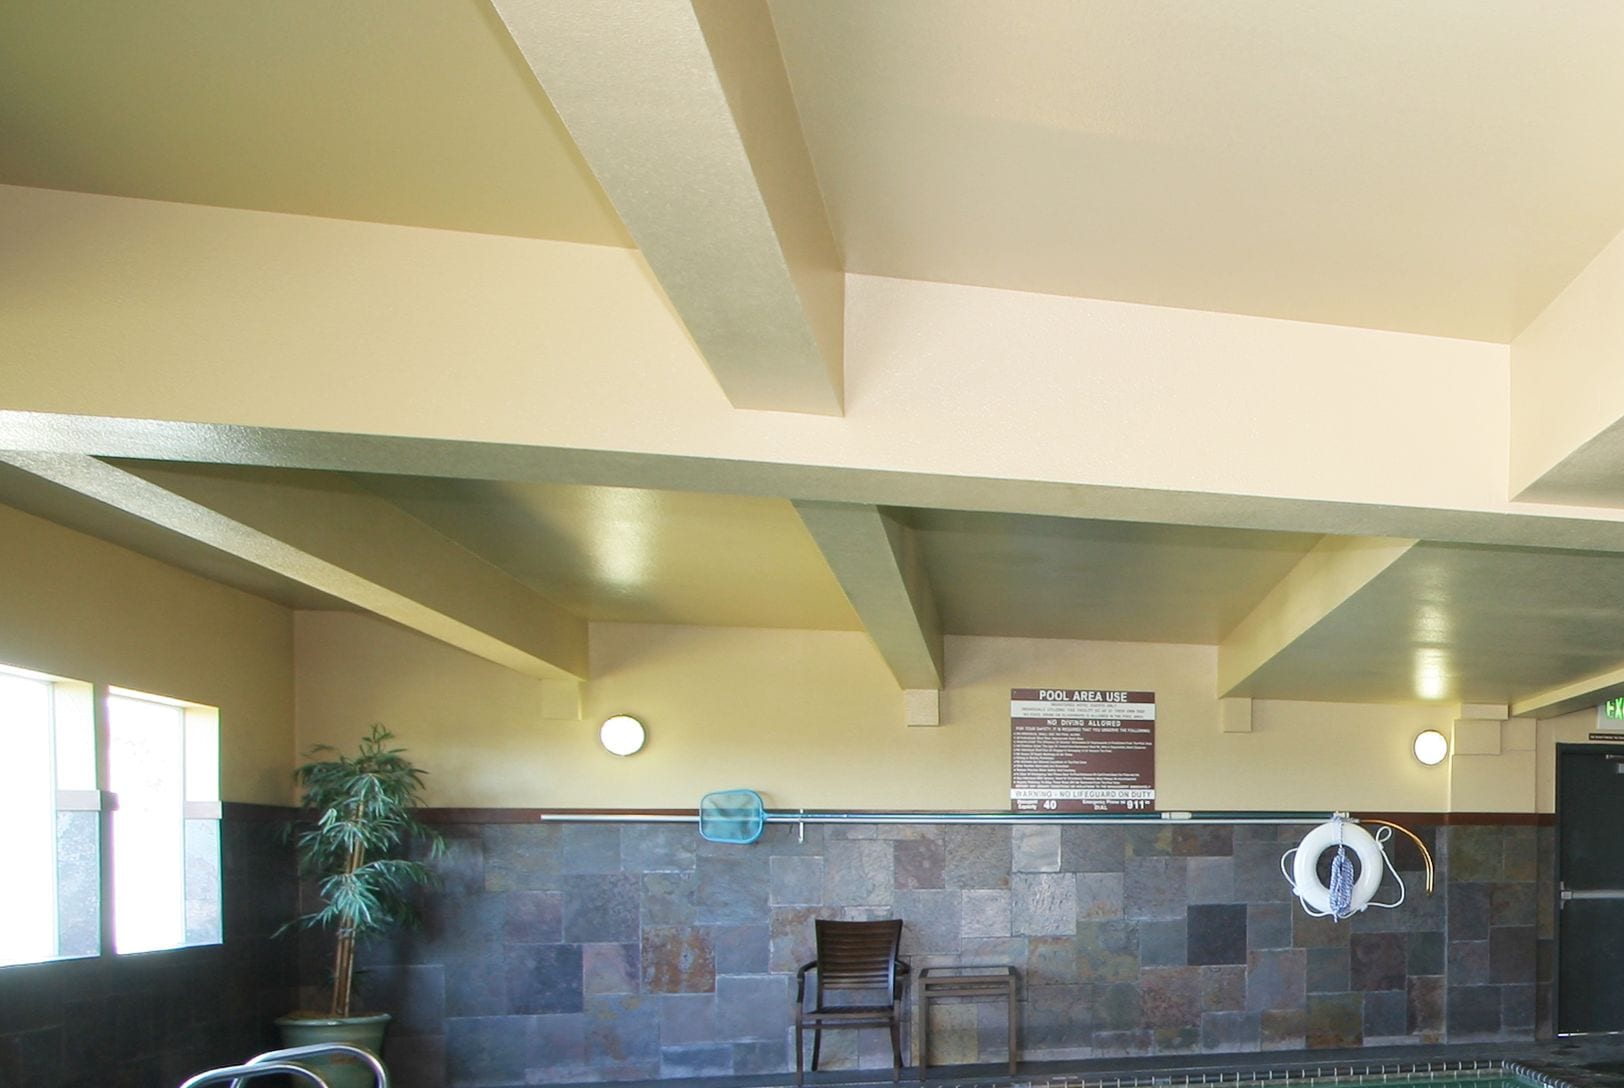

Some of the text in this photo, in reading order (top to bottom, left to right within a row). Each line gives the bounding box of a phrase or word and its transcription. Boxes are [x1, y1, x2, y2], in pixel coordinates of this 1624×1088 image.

[1039, 690, 1128, 702] POOL AREA USE
[1015, 790, 1052, 798] WARNING
[1059, 790, 1071, 798] NO
[1073, 790, 1117, 798] LIFEGUARD
[1118, 790, 1130, 798] ON
[1043, 800, 1057, 810] 40
[1126, 800, 1145, 810] 911
